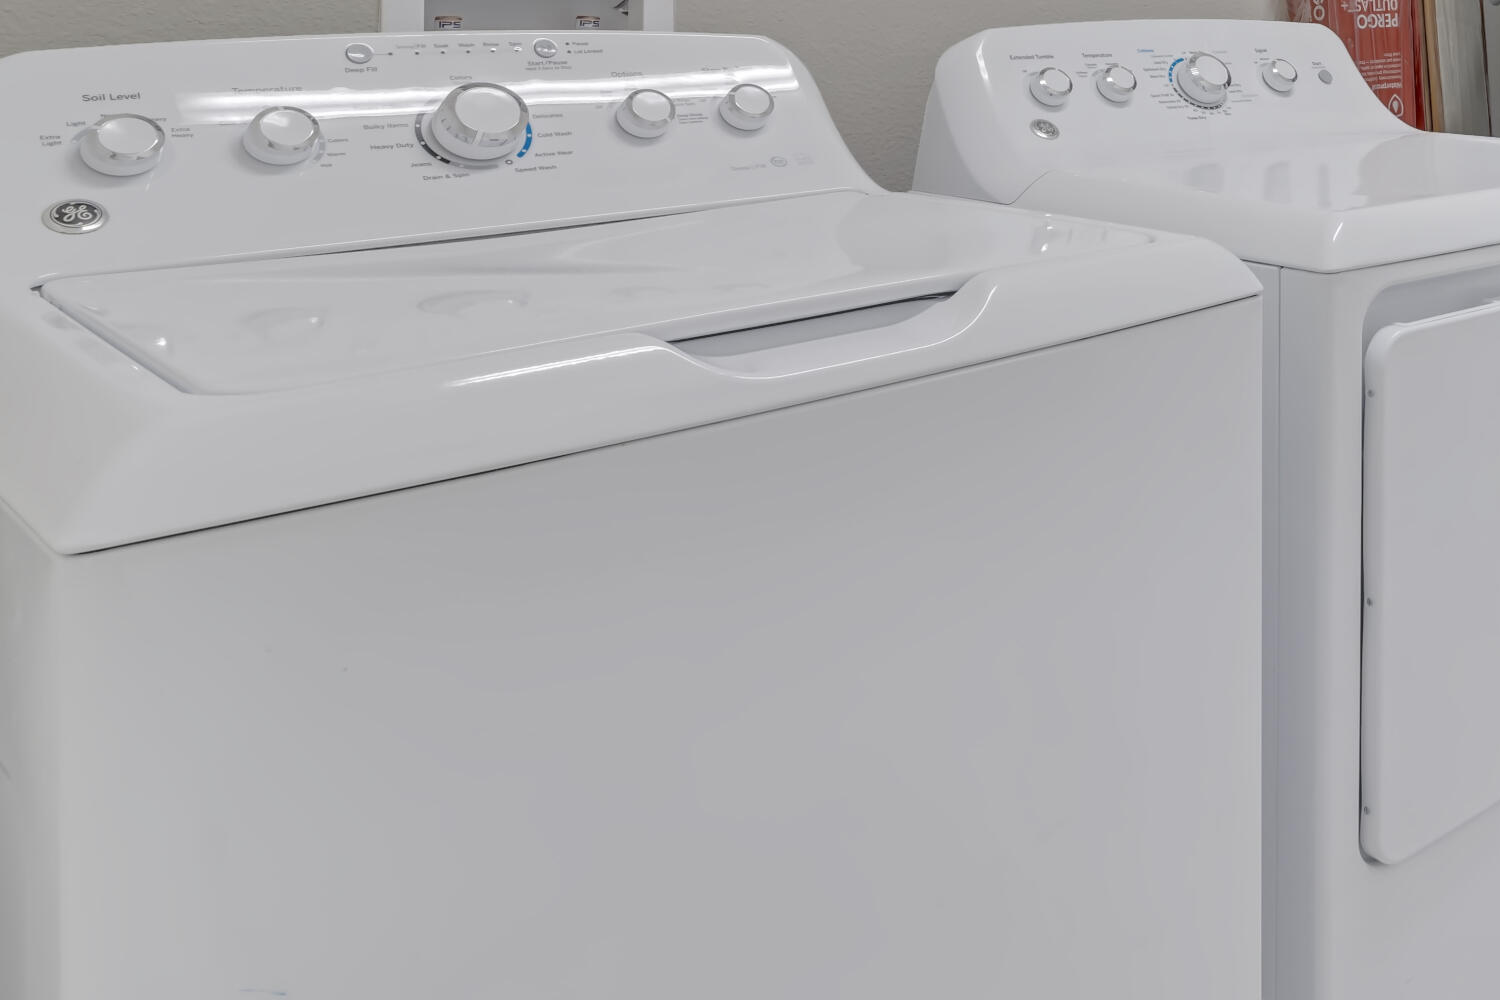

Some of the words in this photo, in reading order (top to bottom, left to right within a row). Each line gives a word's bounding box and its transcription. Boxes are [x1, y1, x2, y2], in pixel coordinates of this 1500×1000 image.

[438, 21, 462, 29] IPS
[579, 20, 600, 28] IPS
[1357, 13, 1399, 29] PERGO
[81, 93, 106, 102] Soil
[110, 92, 141, 101] Level
